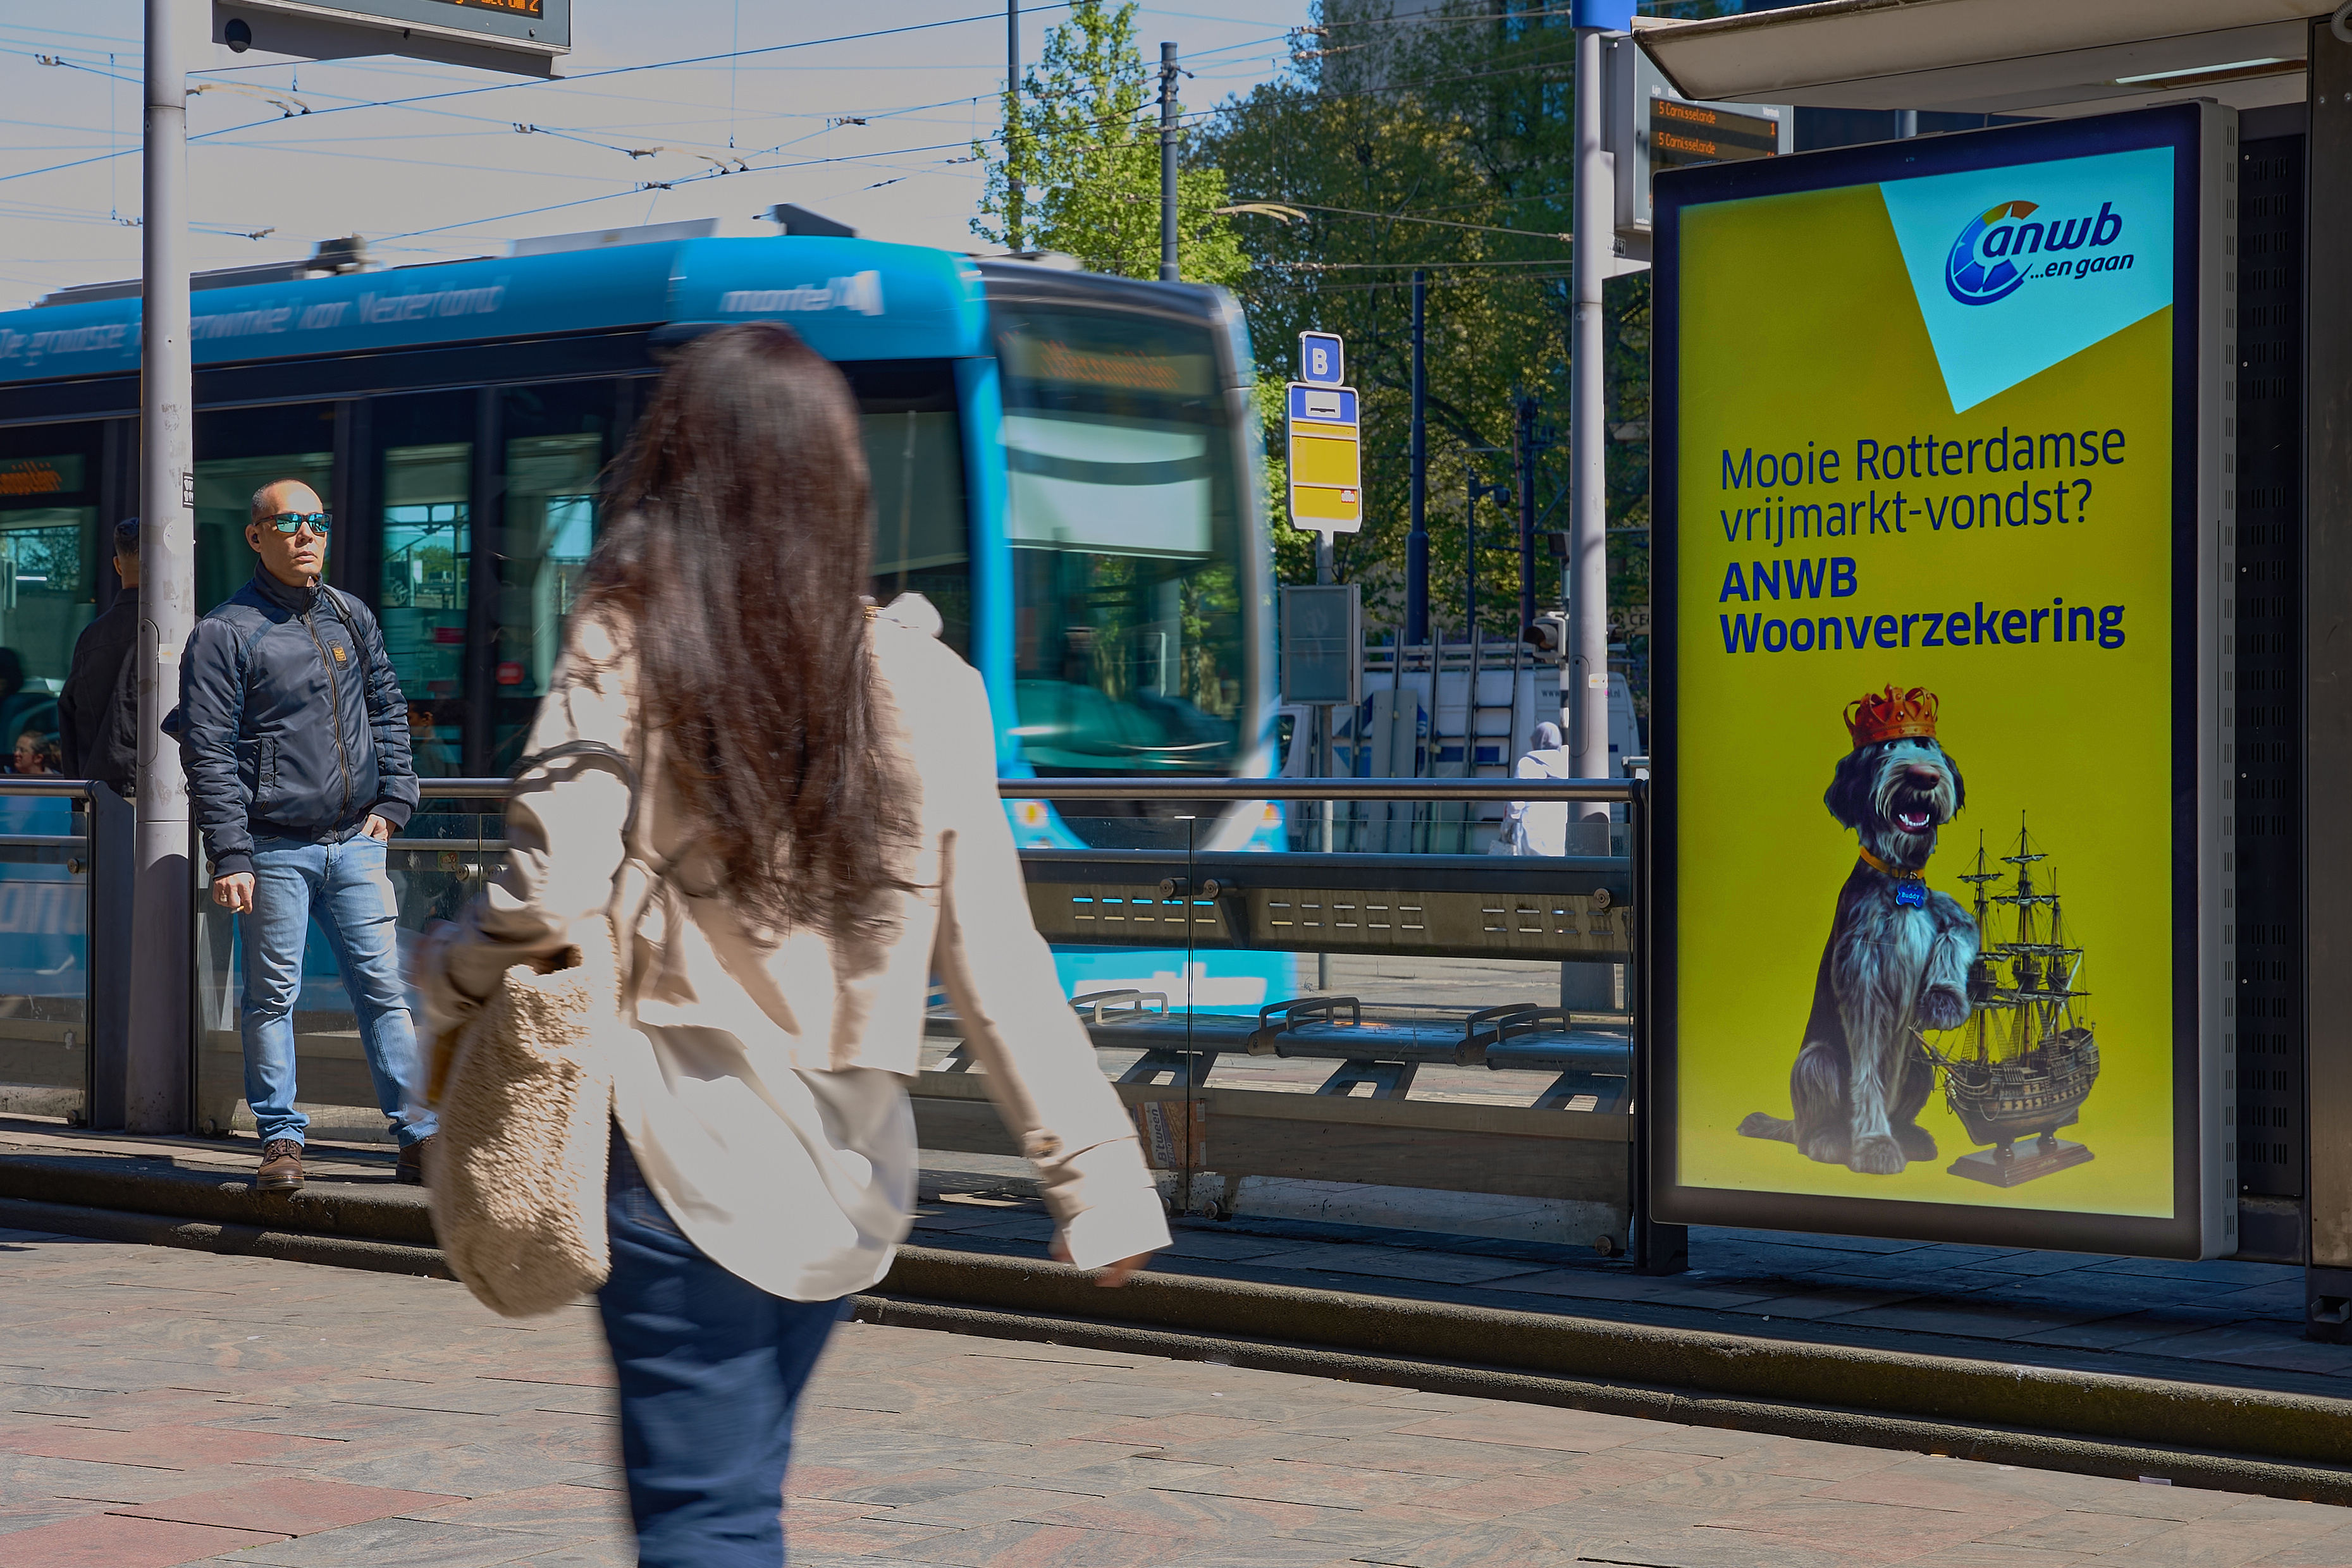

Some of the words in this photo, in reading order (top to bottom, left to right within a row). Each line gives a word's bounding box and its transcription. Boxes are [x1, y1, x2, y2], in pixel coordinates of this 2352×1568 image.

[1659, 101, 1665, 114] 5
[1666, 102, 1716, 124] Carnisselande
[1658, 132, 1665, 145] 5
[1666, 133, 1716, 155] Carnisselande
[1983, 202, 2122, 258] anwb
[2074, 254, 2134, 280] gaan
[1312, 348, 1328, 374] B
[1722, 441, 1840, 489] Mooie
[1857, 427, 2126, 481] Rotterdamse
[1720, 479, 2093, 547] vrijmarkt-vondst?
[1719, 556, 1858, 603] ANWB
[1720, 597, 2126, 654] Woonverzekering
[1902, 891, 1920, 901] Buddy
[1167, 1142, 1175, 1163] ZERO
